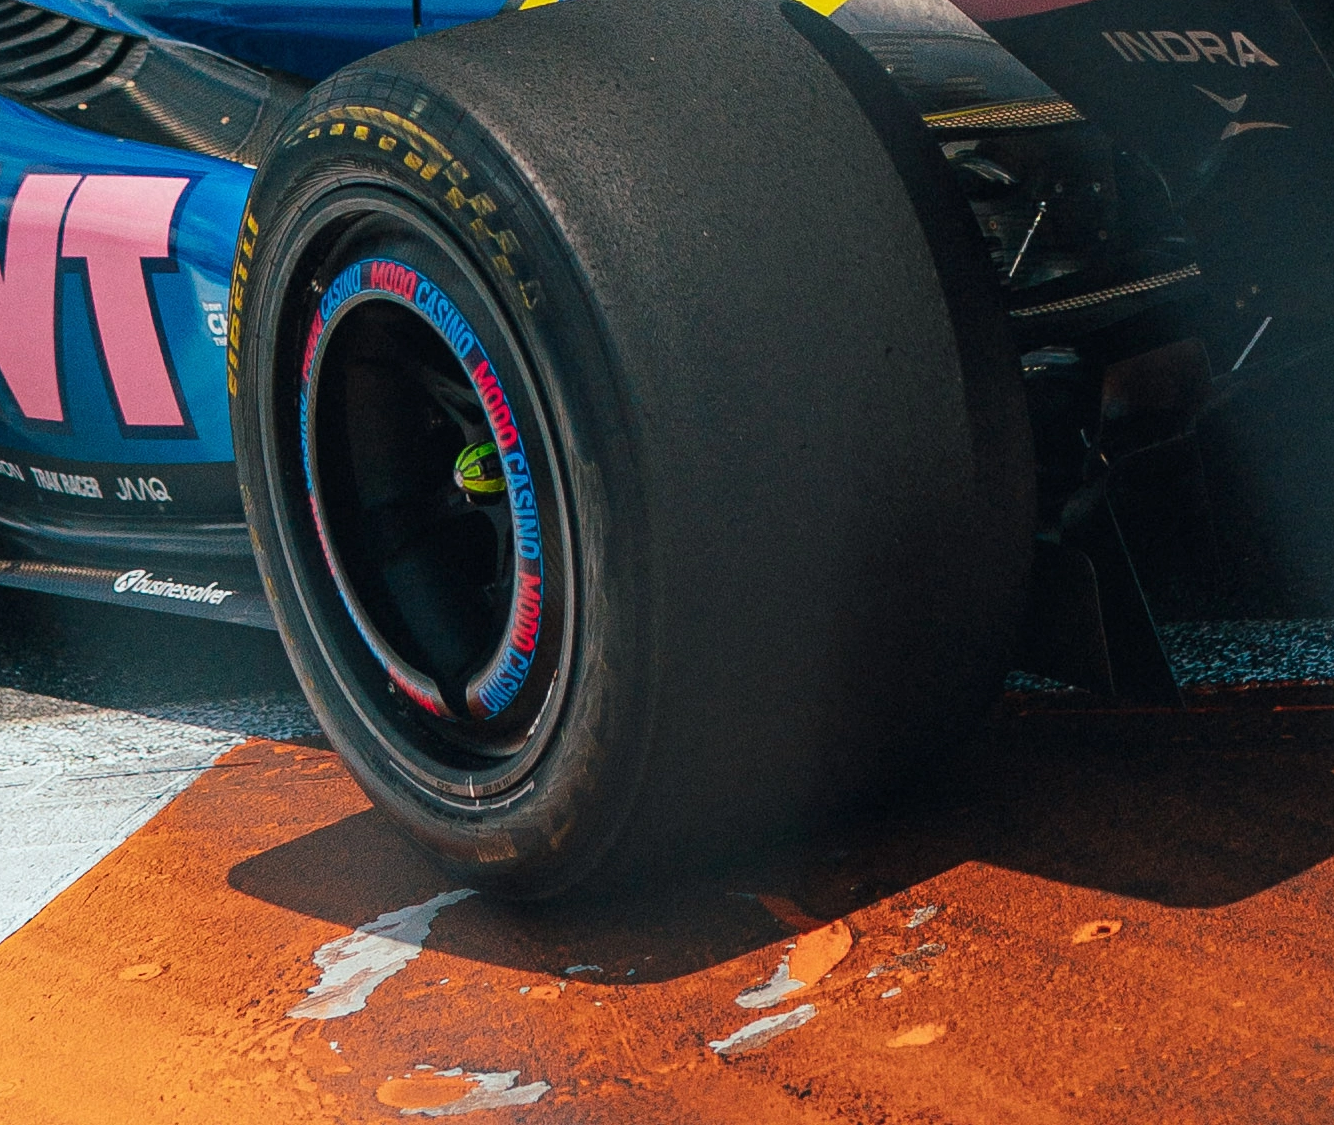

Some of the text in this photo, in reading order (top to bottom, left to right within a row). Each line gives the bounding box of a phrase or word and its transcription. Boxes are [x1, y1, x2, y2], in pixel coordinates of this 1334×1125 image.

[1102, 31, 1279, 67] INDRA
[320, 264, 362, 322] CASINO
[369, 260, 475, 360] MODO CASINO
[472, 360, 542, 561] MODO CASINO
[131, 572, 233, 605] businessolver
[477, 570, 542, 713] MODO CASINO
